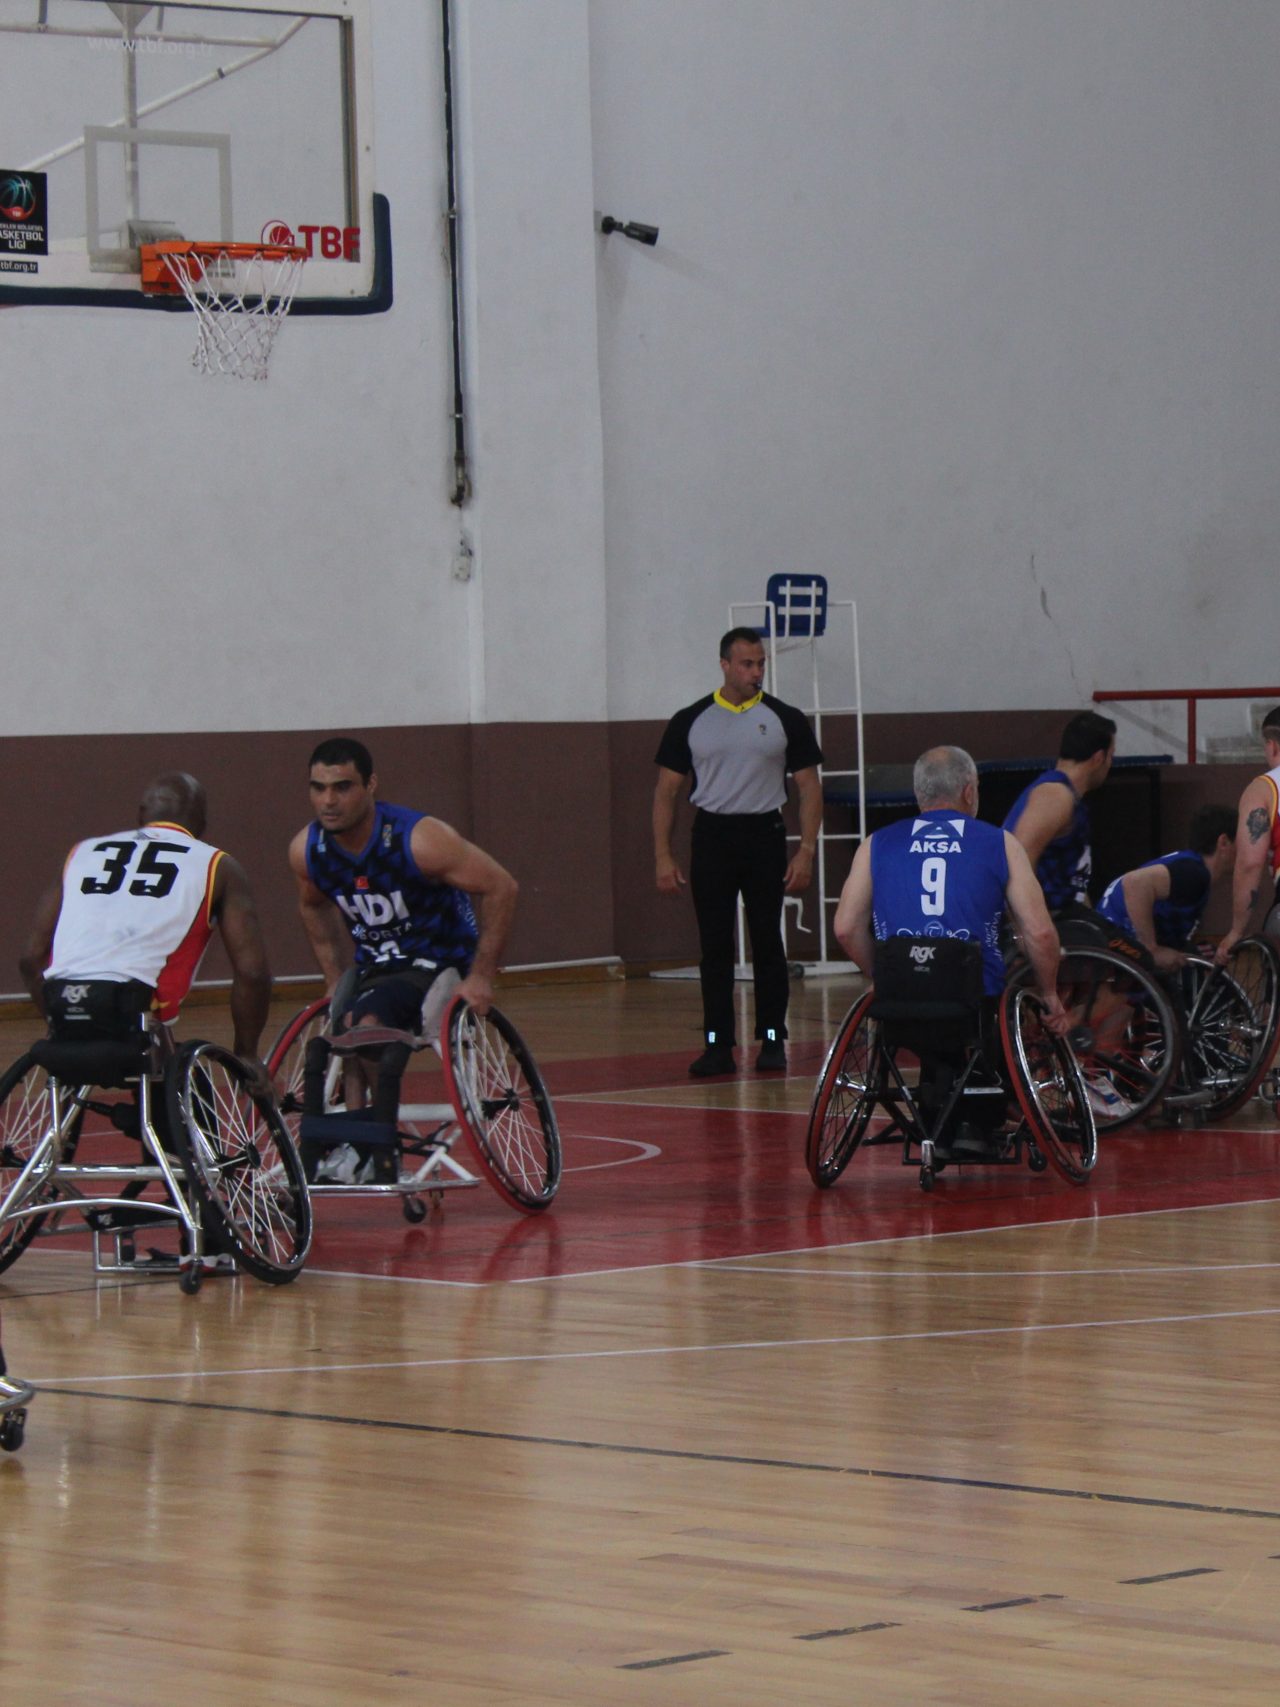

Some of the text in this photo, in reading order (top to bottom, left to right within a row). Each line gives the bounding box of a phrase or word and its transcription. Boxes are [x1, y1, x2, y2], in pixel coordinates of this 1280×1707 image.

[298, 225, 361, 261] TBF
[909, 840, 962, 853] AKSA
[81, 841, 191, 898] 35
[921, 857, 946, 916] 9
[336, 890, 410, 926] HDI
